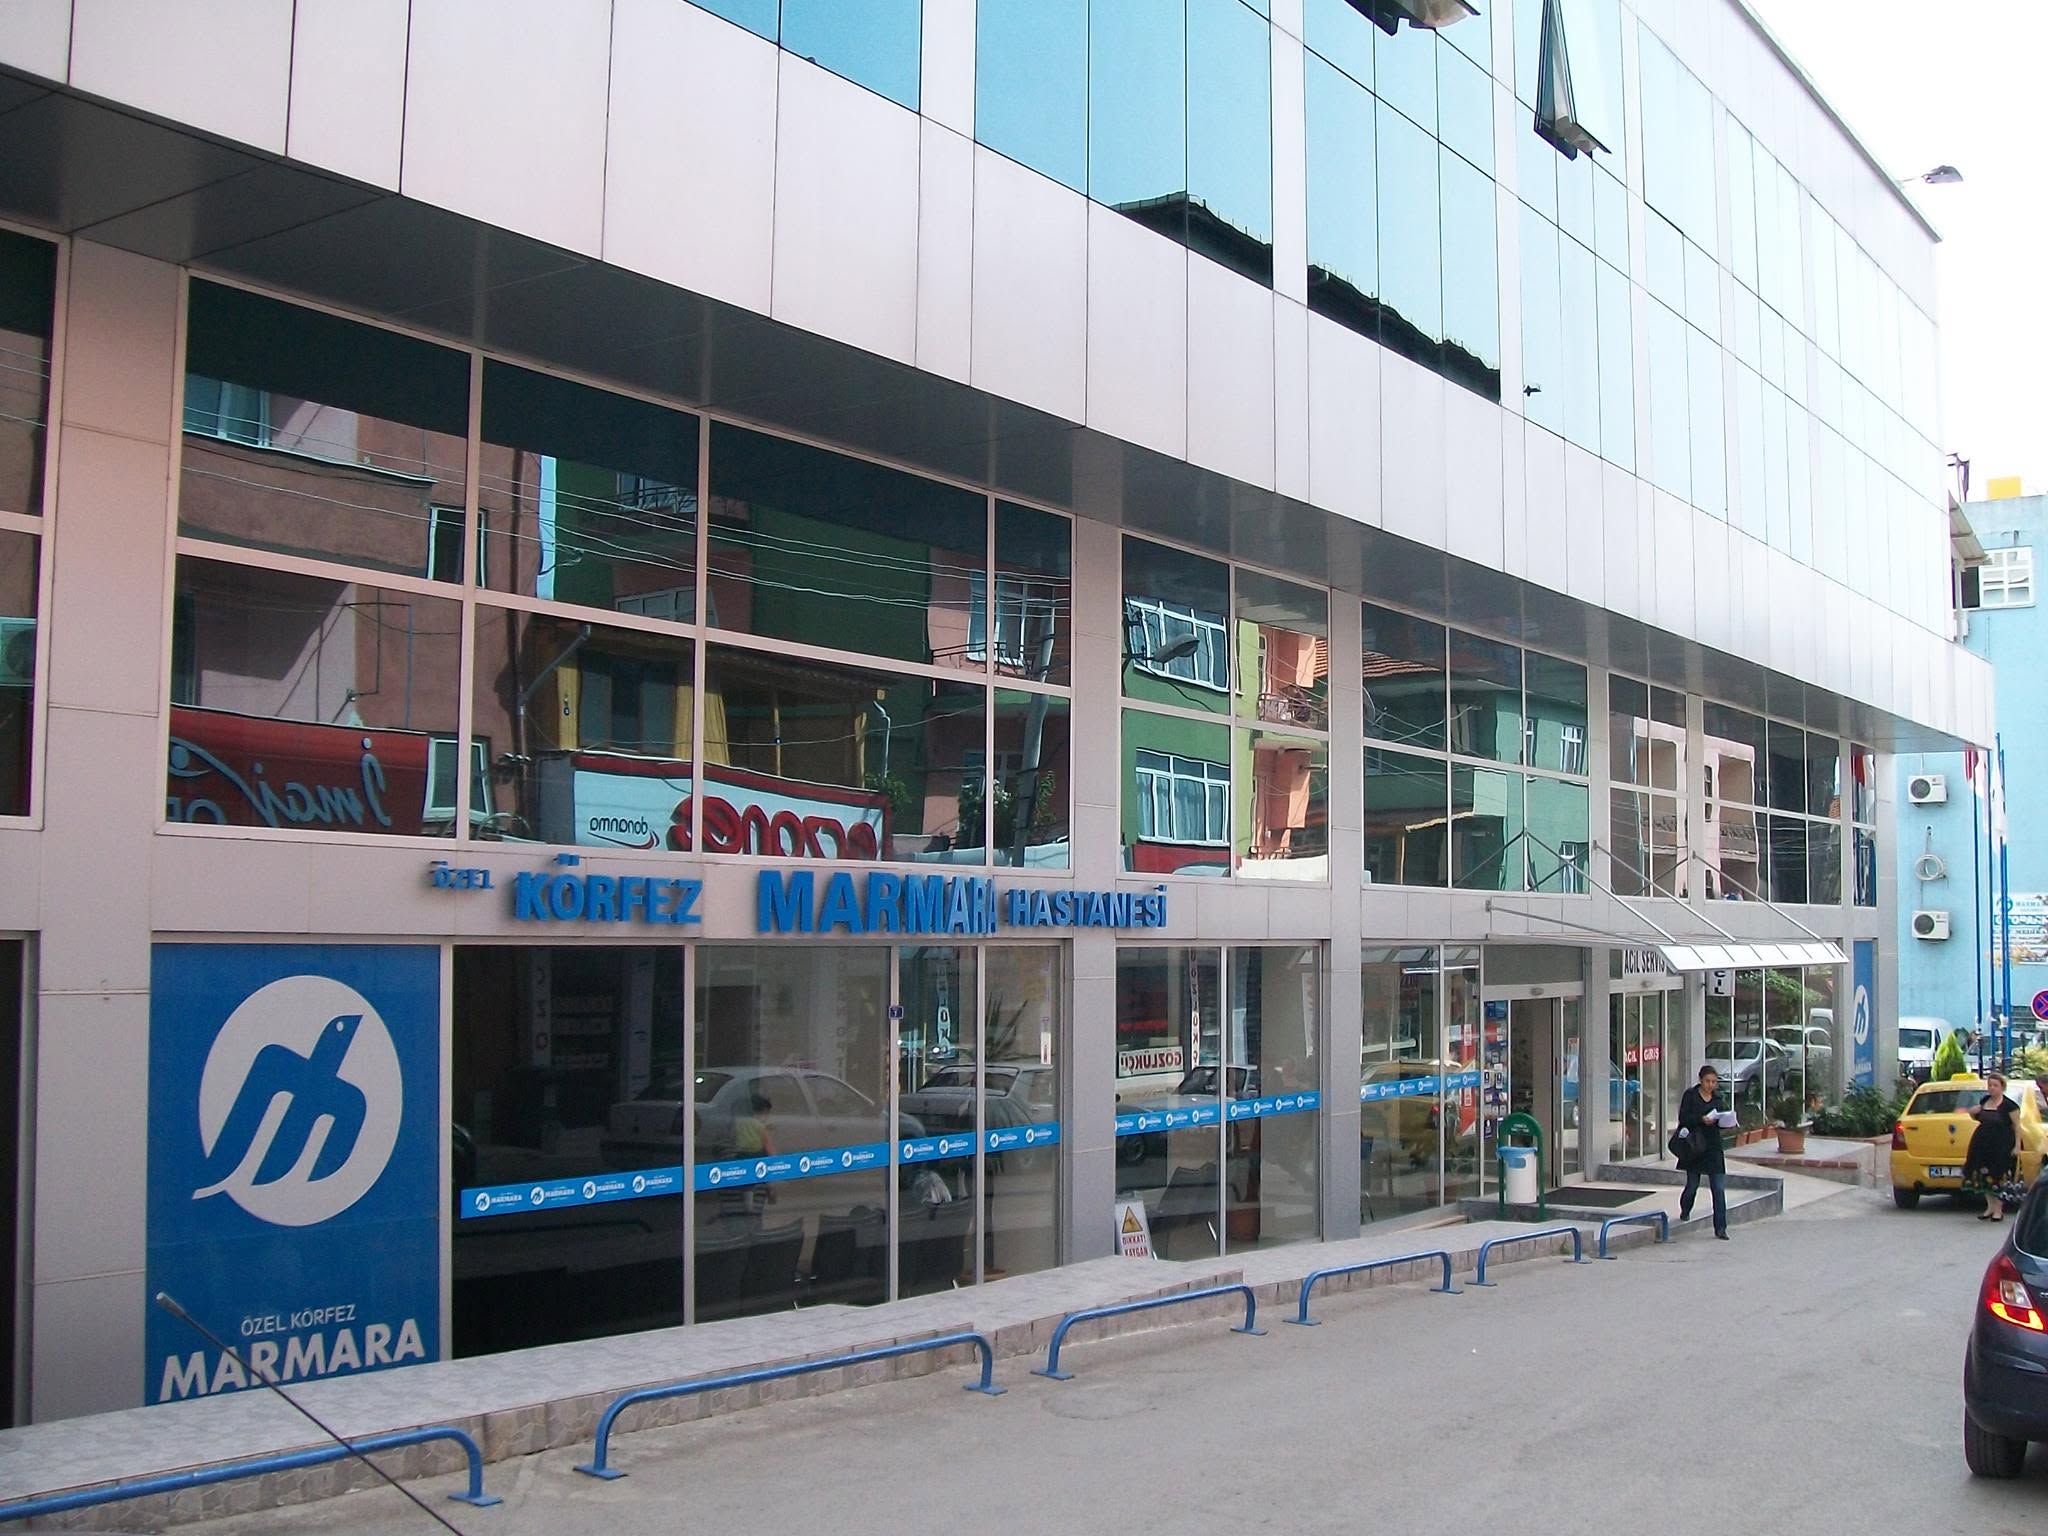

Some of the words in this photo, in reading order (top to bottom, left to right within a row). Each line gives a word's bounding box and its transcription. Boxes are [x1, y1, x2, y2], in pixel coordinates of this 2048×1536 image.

[430, 861, 495, 889] ÖZEL
[514, 853, 703, 924] KÖRFEZ
[757, 869, 998, 935] MARMARA
[1006, 884, 1168, 929] HASTANESİ
[159, 1318, 425, 1402] MARMARA
[241, 1316, 286, 1336] ÖZEL
[290, 1304, 356, 1329] KÖRFEZ
